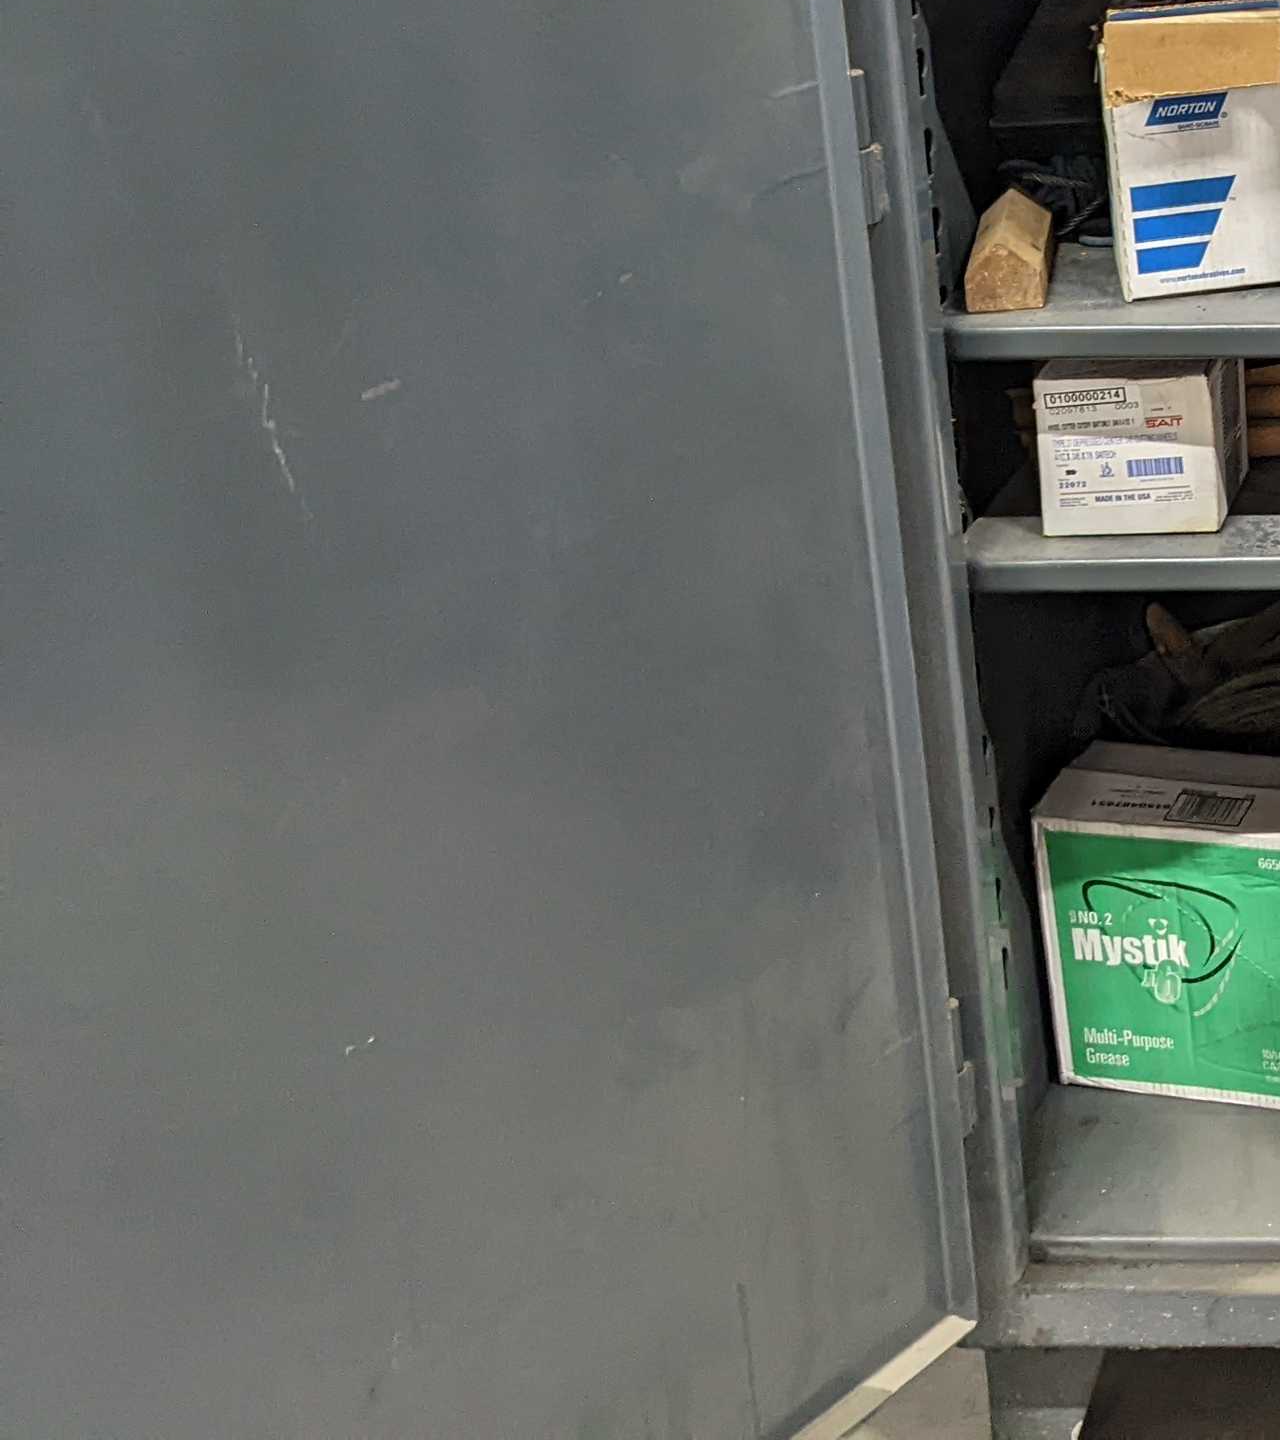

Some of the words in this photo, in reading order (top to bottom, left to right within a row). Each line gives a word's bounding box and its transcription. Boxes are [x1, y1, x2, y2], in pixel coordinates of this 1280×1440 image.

[1155, 101, 1217, 118] NORTON
[1049, 389, 1120, 405] 0100000214
[1144, 417, 1183, 428] SAIT
[1094, 493, 1113, 503] MADE
[1115, 494, 1122, 502] IN
[1123, 493, 1136, 501] THE
[1137, 492, 1151, 501] USA
[1078, 911, 1102, 926] NO.
[1104, 912, 1113, 926] 2
[1071, 927, 1190, 968] Mystik
[1083, 1027, 1175, 1051] Multi-Purpose
[1086, 1049, 1130, 1067] Grease
